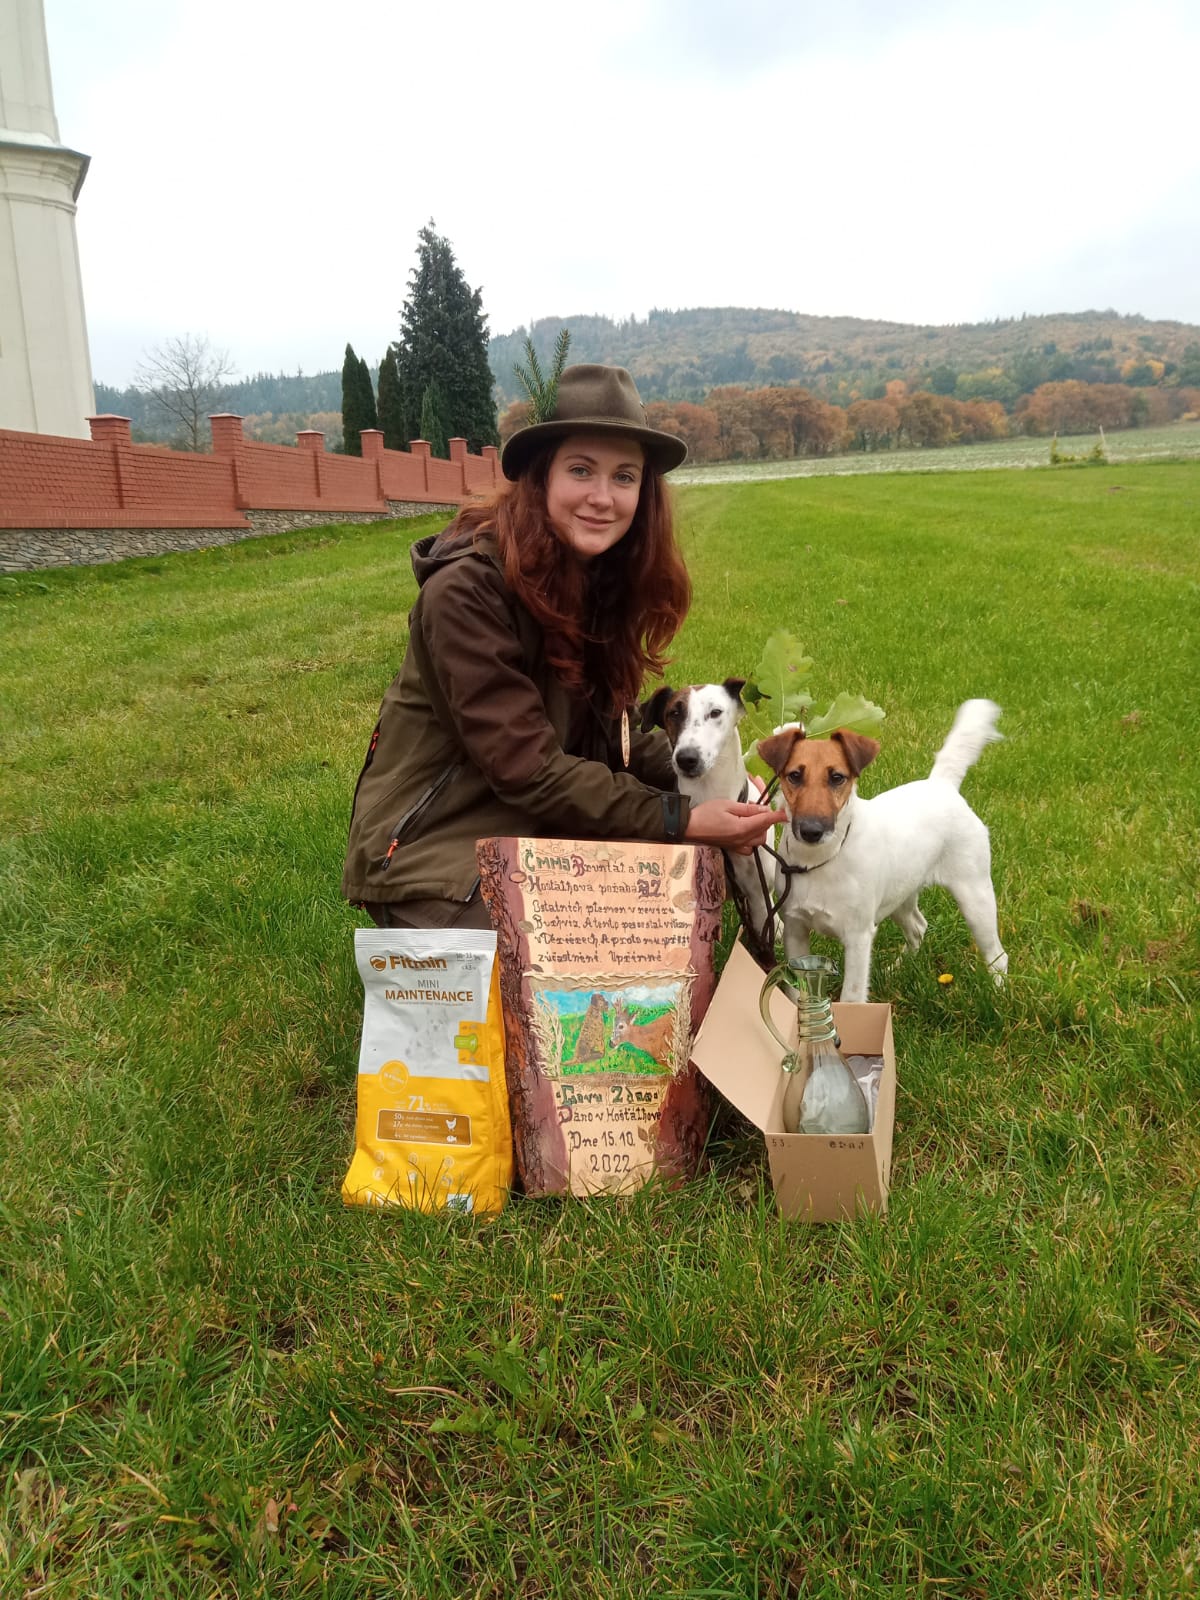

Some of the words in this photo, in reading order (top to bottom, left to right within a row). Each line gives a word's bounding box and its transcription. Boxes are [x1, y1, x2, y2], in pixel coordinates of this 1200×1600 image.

[389, 955, 448, 970] Fitmin
[417, 979, 440, 989] MINI
[385, 989, 474, 1002] MAINTENANCE
[568, 1131, 598, 1152] Dne
[590, 1154, 631, 1173] 2022
